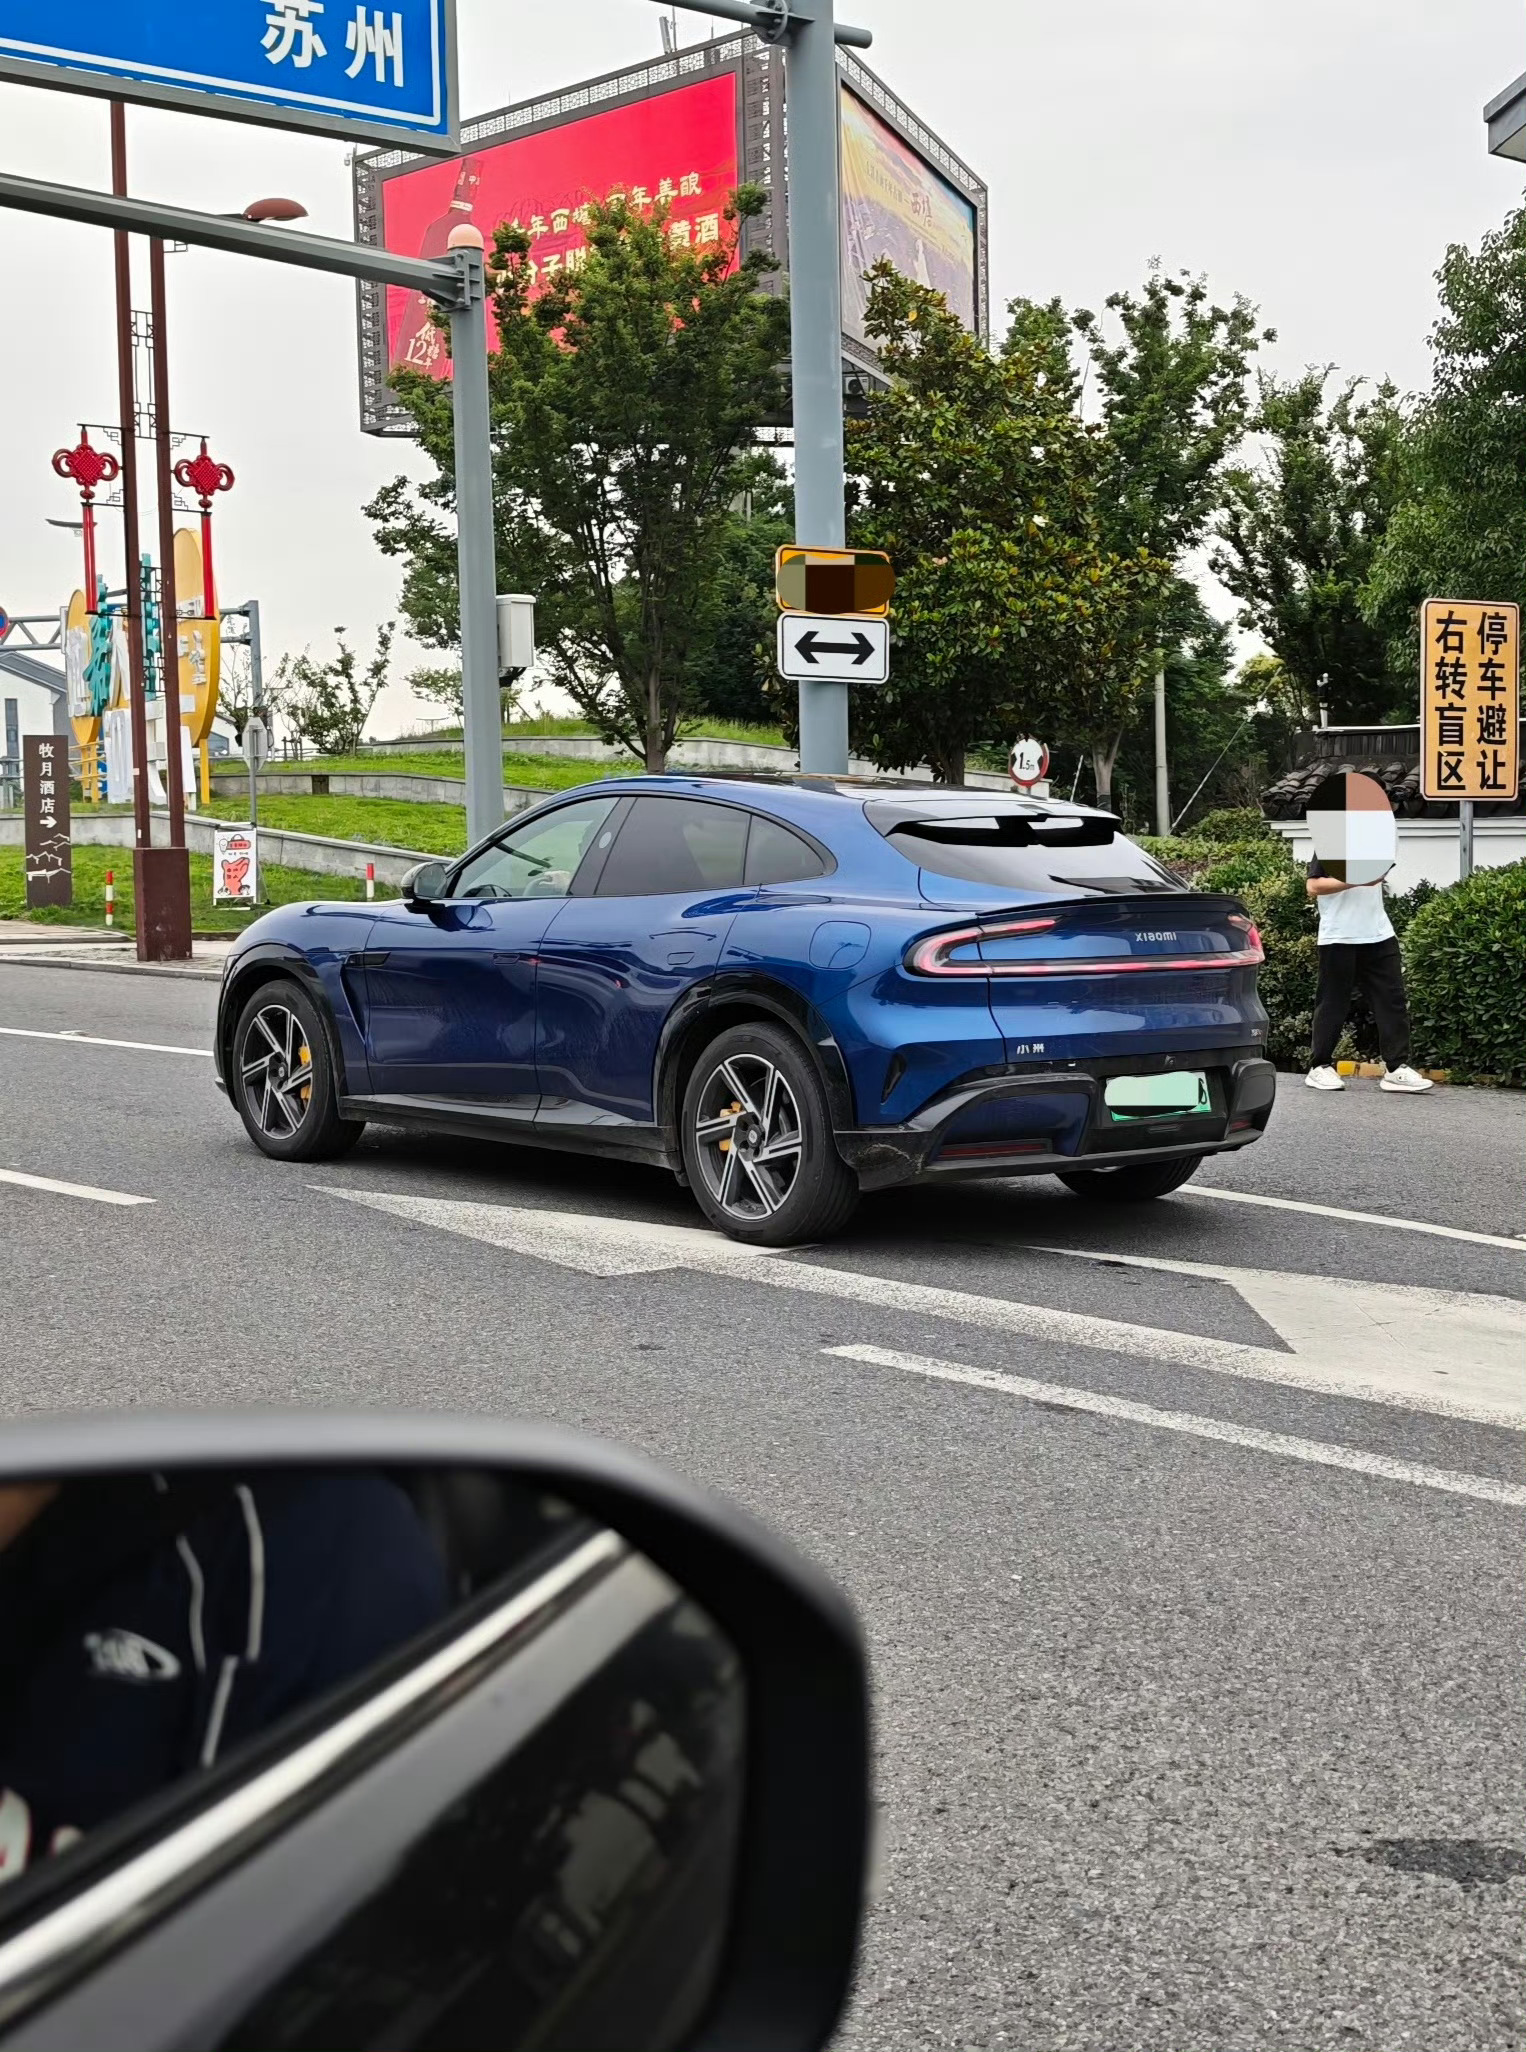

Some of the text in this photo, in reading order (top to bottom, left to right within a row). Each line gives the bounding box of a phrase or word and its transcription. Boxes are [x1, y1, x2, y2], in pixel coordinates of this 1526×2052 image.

[259, 0, 404, 88] 苏州
[1435, 610, 1467, 790] 右转盲区
[1476, 611, 1507, 790] 停车避让
[39, 743, 55, 813] 牧月酒店
